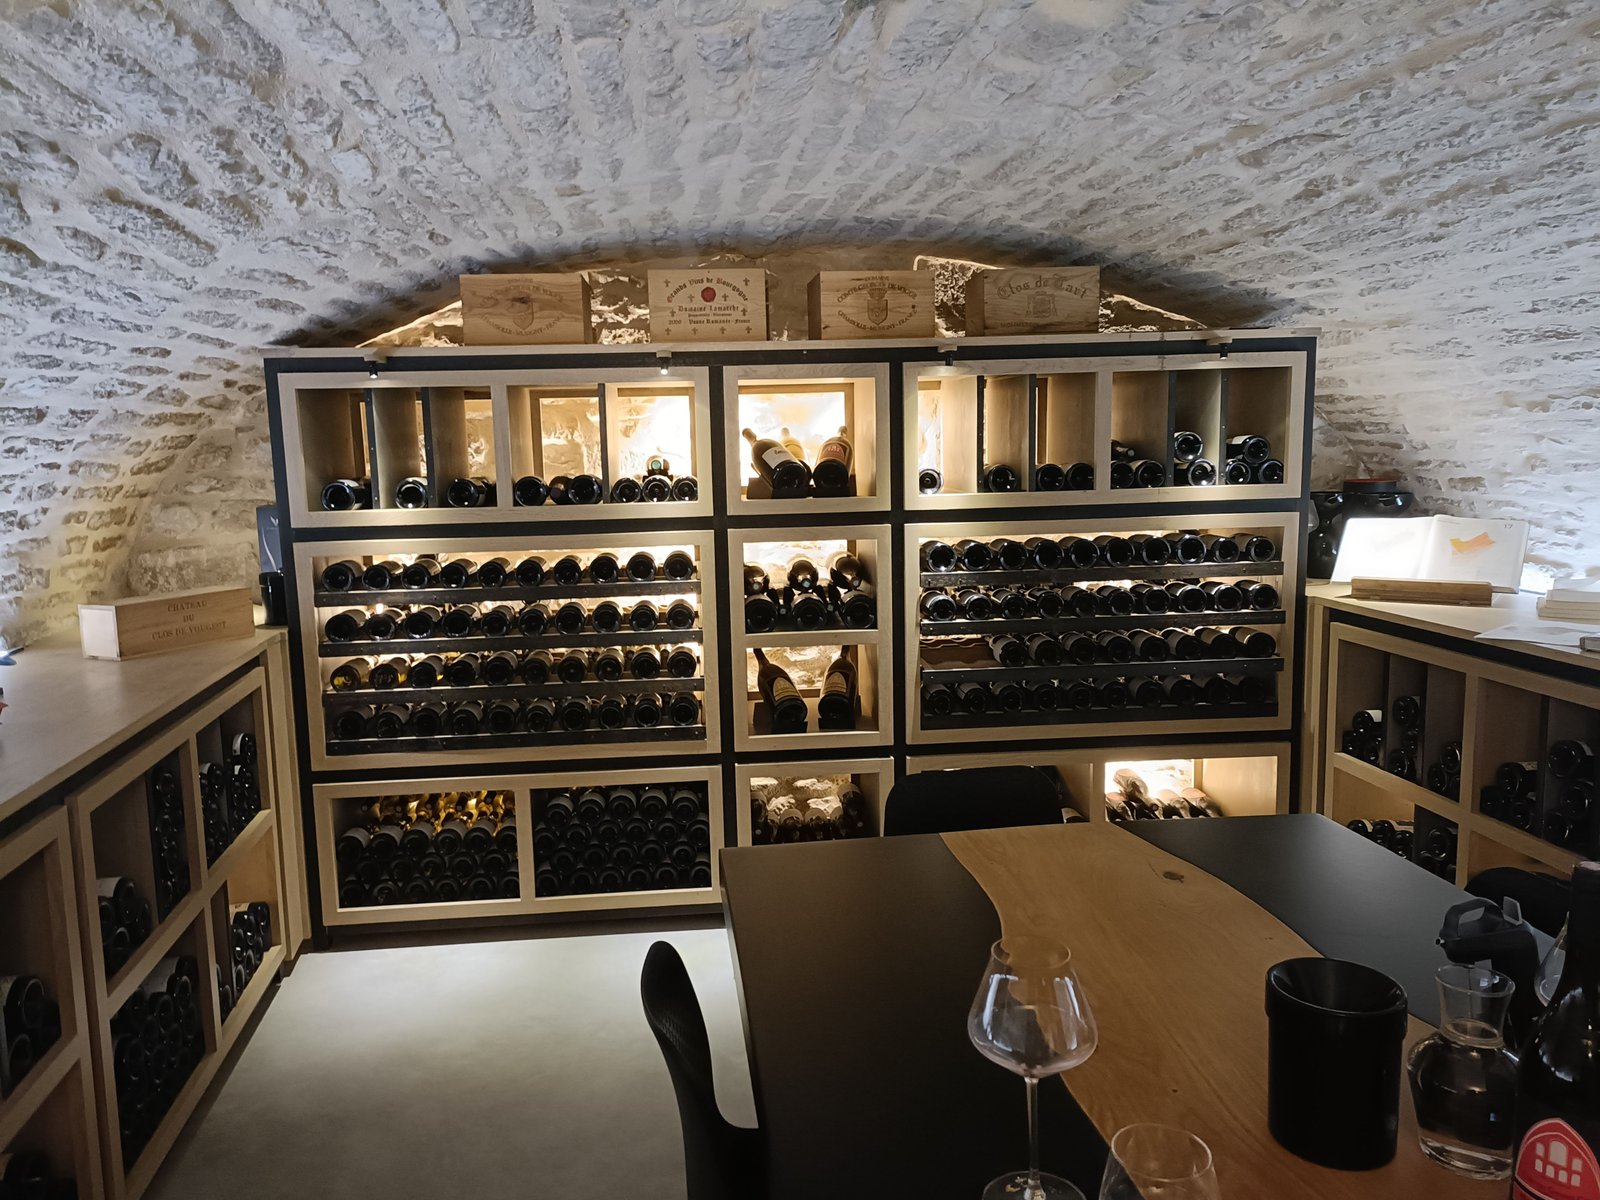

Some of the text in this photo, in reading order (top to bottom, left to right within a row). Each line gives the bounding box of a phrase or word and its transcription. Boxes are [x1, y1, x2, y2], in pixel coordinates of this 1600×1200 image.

[666, 283, 687, 303] Grands
[688, 278, 704, 286] Vins
[716, 277, 749, 302] Bourgogne
[996, 281, 1030, 300] Clos
[1035, 274, 1050, 288] de
[709, 304, 740, 312] Lamarche
[183, 614, 194, 623] DU
[152, 630, 173, 641] CLOS
[188, 621, 226, 634] VOUGEOT
